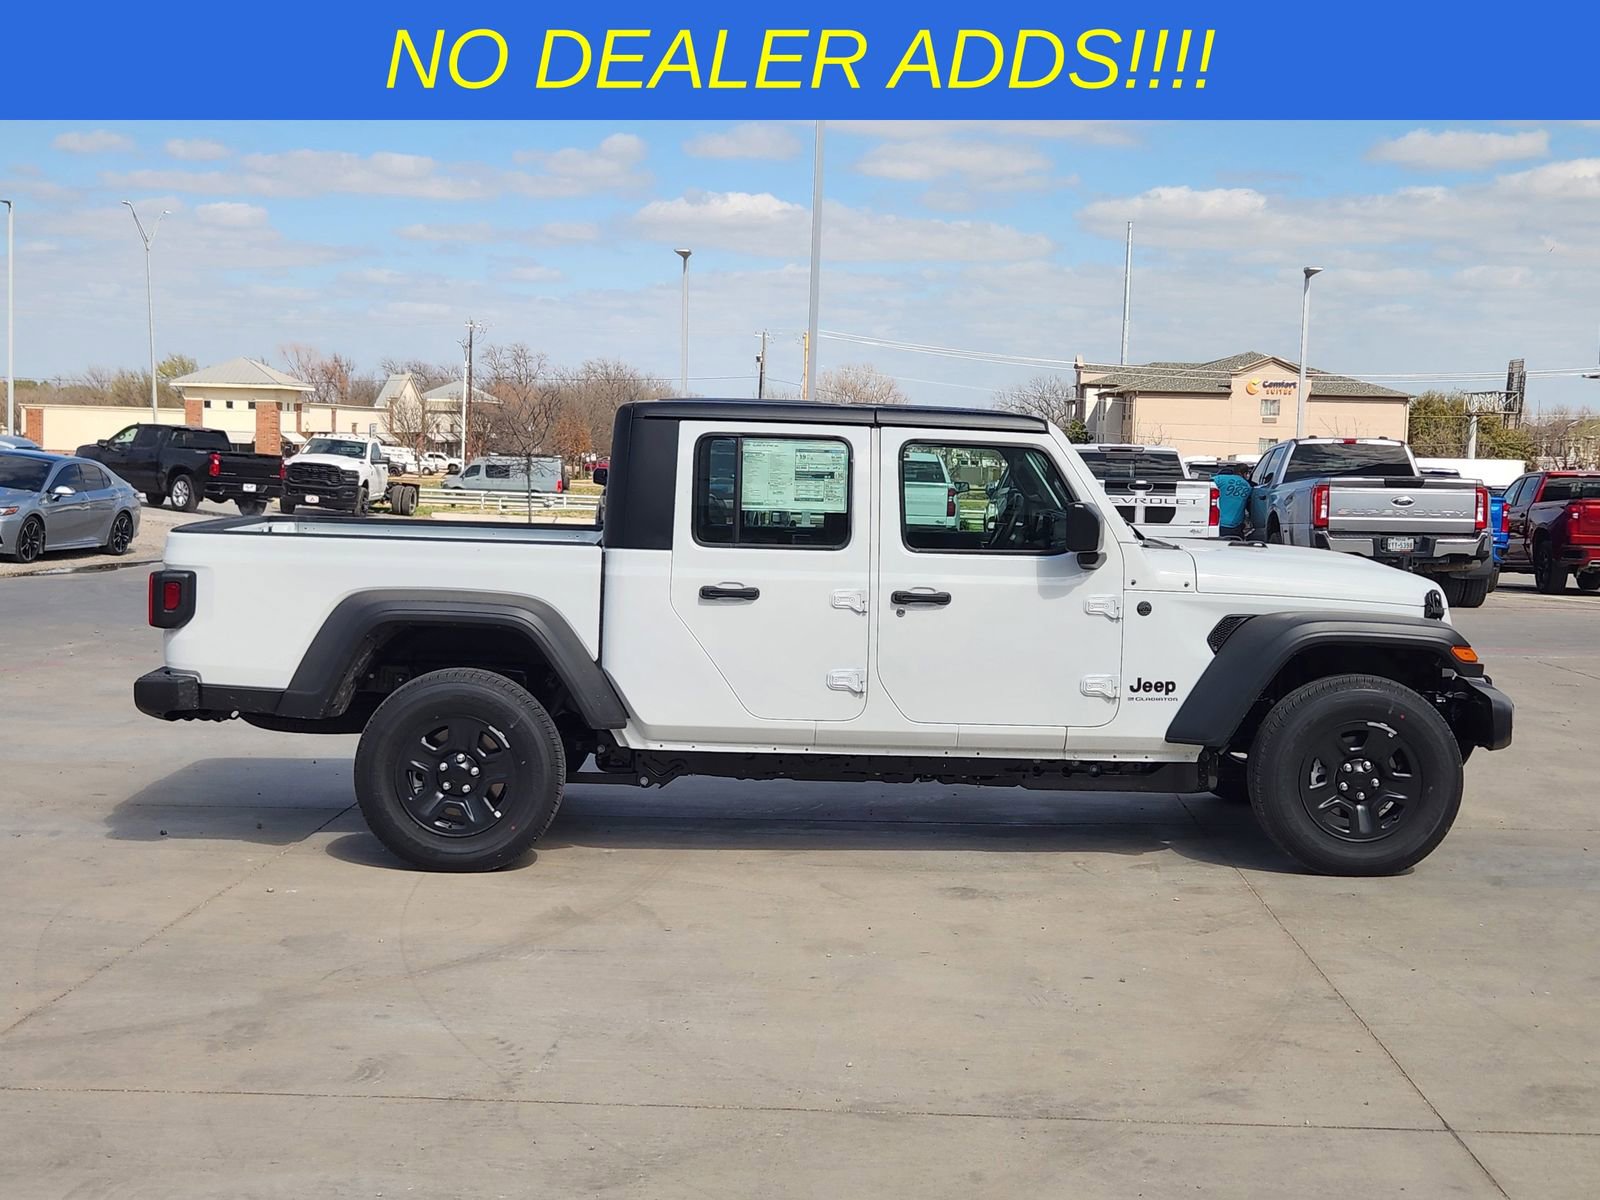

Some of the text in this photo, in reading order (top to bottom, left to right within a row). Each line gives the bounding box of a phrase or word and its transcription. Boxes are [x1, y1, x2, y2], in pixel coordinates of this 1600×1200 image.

[1262, 380, 1297, 389] Comfort
[1109, 496, 1198, 505] EVROLET
[1337, 508, 1468, 517] SUPER DUTY
[1129, 677, 1176, 695] Jeep
